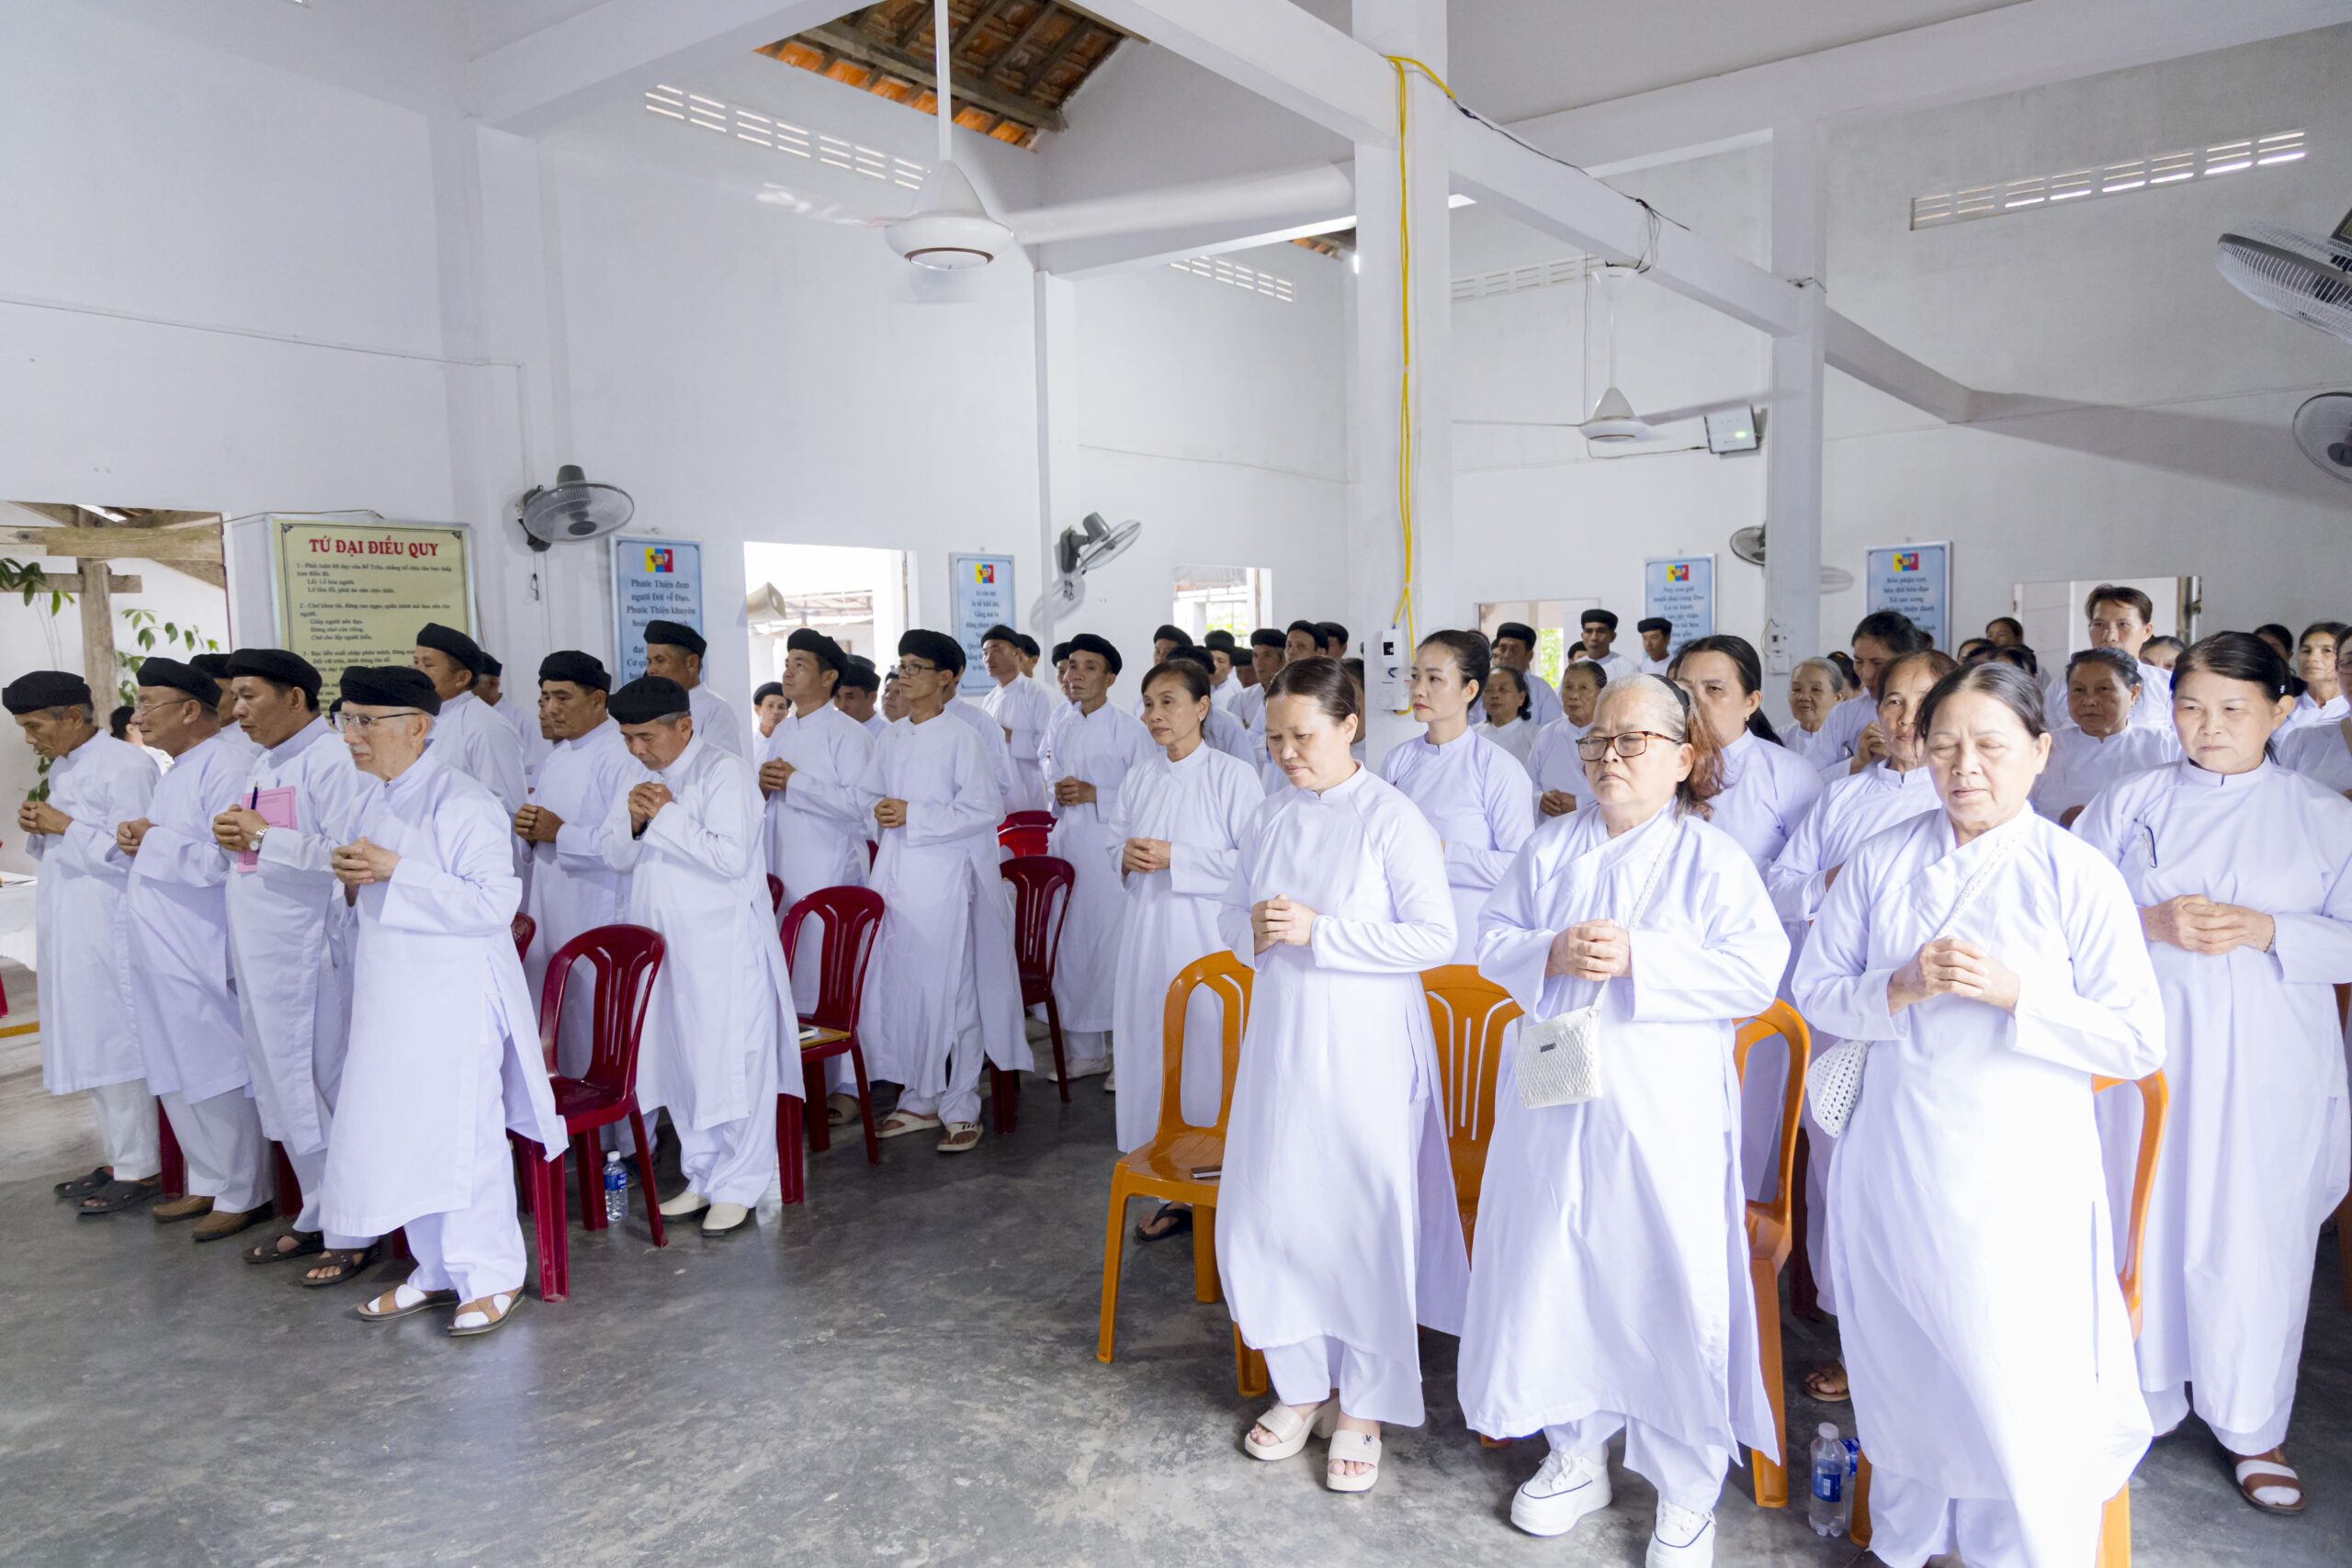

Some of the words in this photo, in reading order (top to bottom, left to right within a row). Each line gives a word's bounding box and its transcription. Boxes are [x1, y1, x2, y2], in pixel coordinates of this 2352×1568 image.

[309, 535, 332, 553] TỨ
[335, 539, 365, 558] ĐẠI
[368, 534, 404, 556] ĐIỀU
[408, 542, 439, 558] QUY
